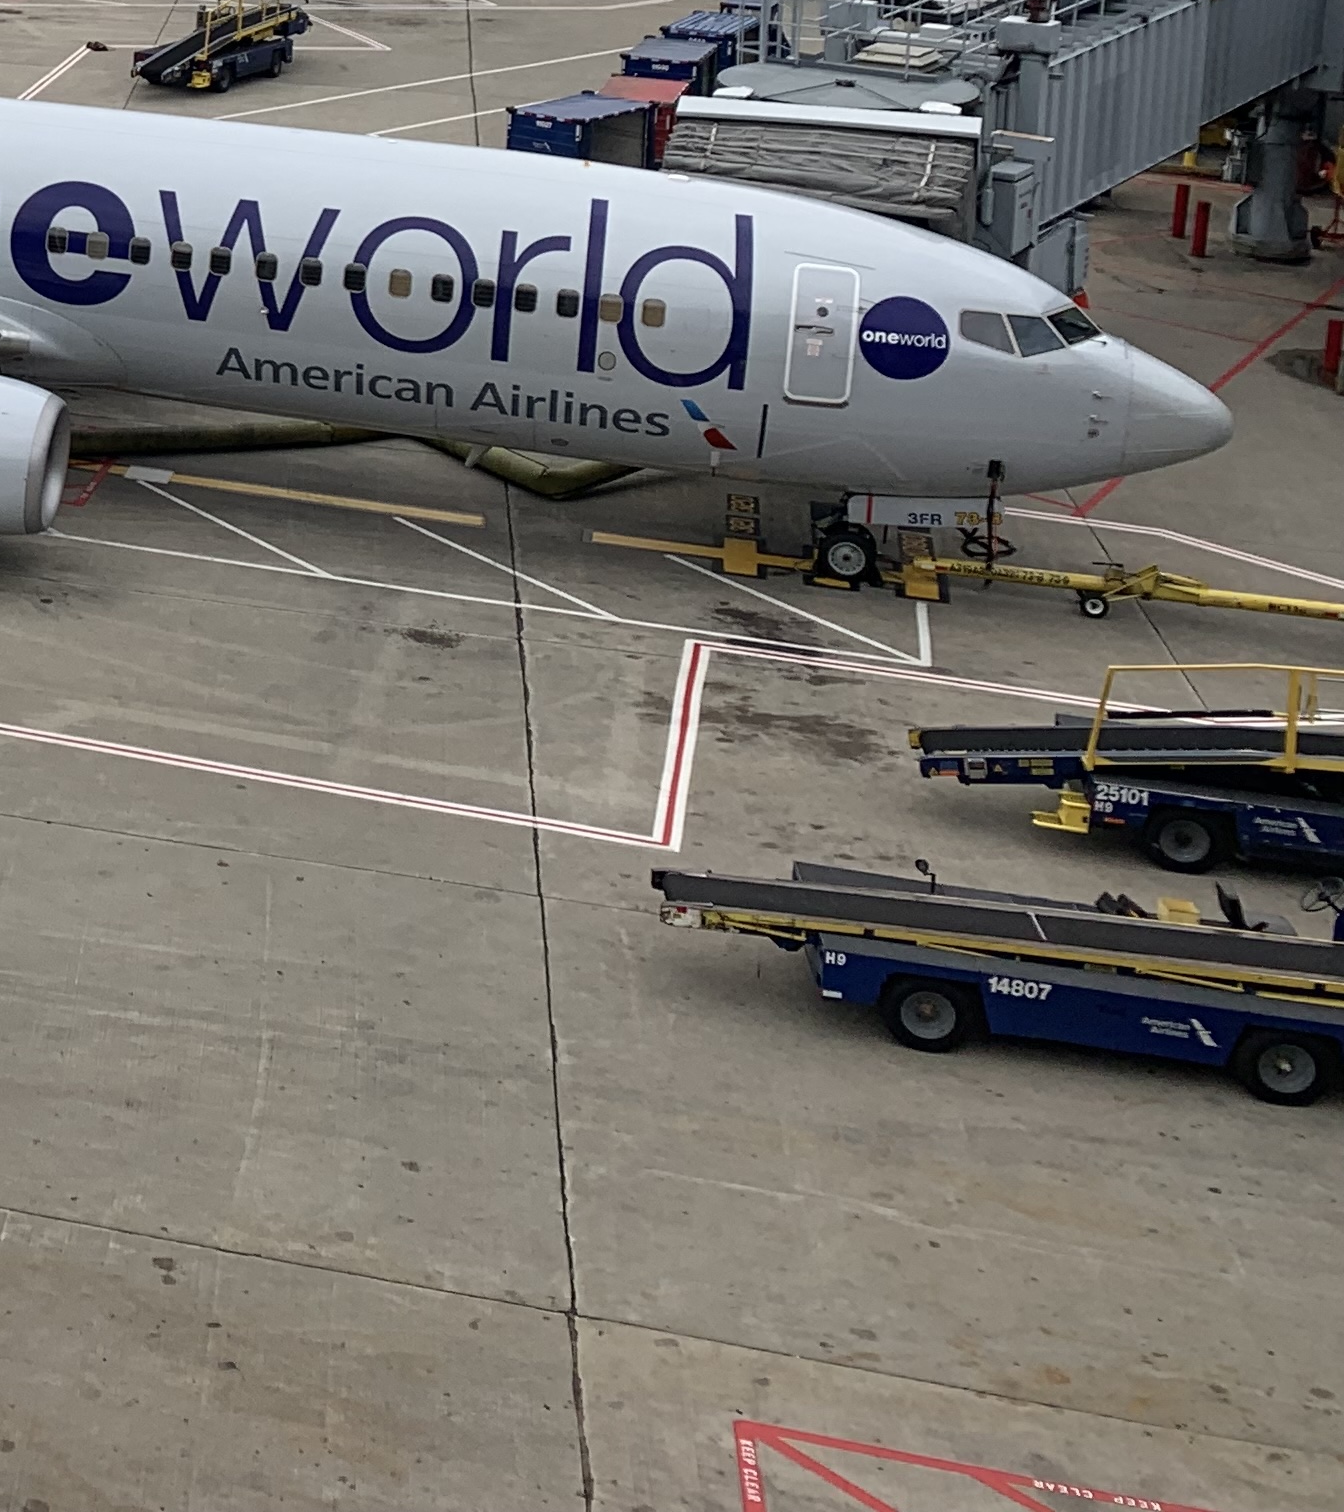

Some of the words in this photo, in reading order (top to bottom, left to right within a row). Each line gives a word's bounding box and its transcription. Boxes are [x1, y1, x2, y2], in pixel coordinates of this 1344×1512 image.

[862, 329, 946, 349] oneworld
[217, 347, 455, 408] American
[470, 382, 670, 437] Airlines
[907, 512, 943, 525] 3FR
[1095, 784, 1150, 806] 25101
[824, 951, 846, 966] H9
[988, 976, 1053, 1001] 14807
[739, 1439, 757, 1466] KEEP
[743, 1468, 762, 1503] CLEAR
[1032, 1479, 1094, 1499] CLEAR
[1113, 1495, 1162, 1512] KEEP
